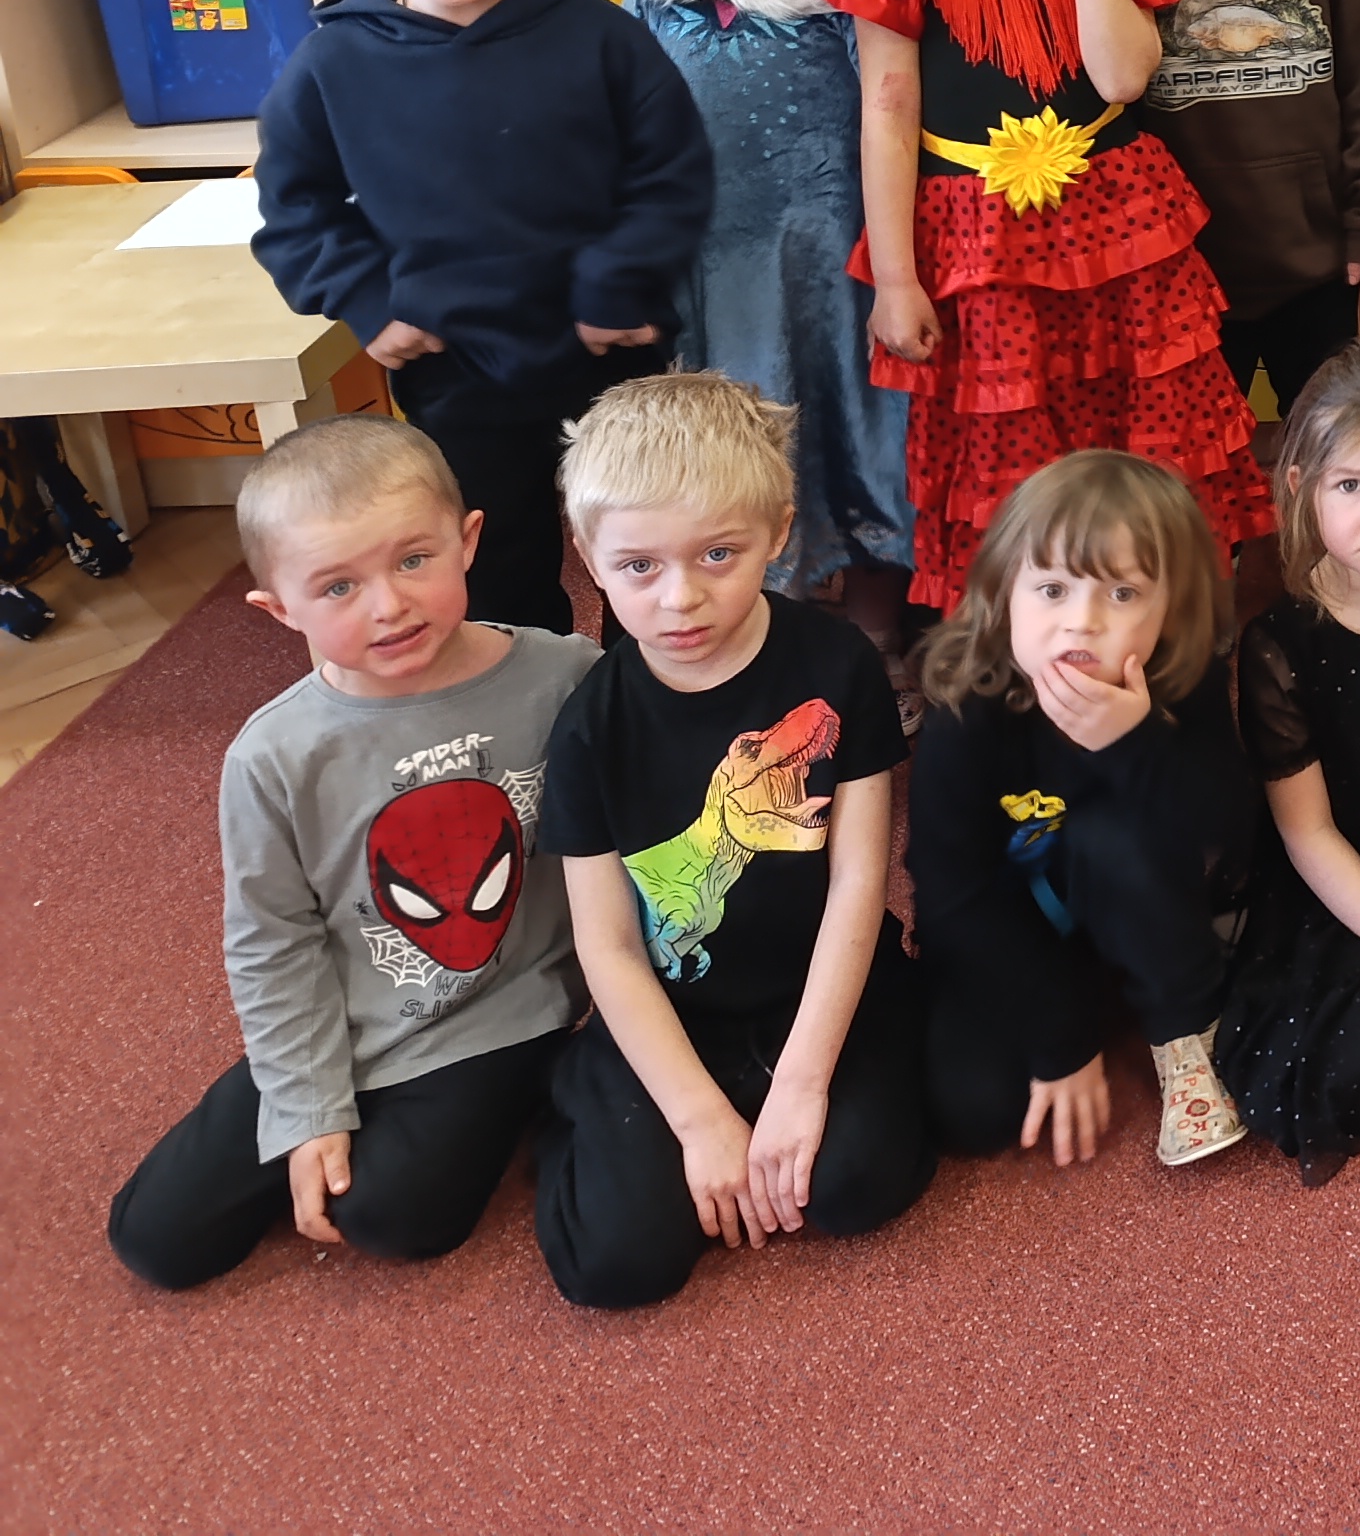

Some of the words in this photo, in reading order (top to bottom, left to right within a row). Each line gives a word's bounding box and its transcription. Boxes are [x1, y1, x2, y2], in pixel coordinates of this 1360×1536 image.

[1163, 86, 1178, 97] IS
[1183, 85, 1205, 95] MY
[1206, 83, 1242, 94] WAY
[1242, 83, 1263, 92] OF
[1265, 79, 1298, 90] LIFE
[393, 732, 495, 776] SPIDER-
[422, 754, 471, 783] MAN
